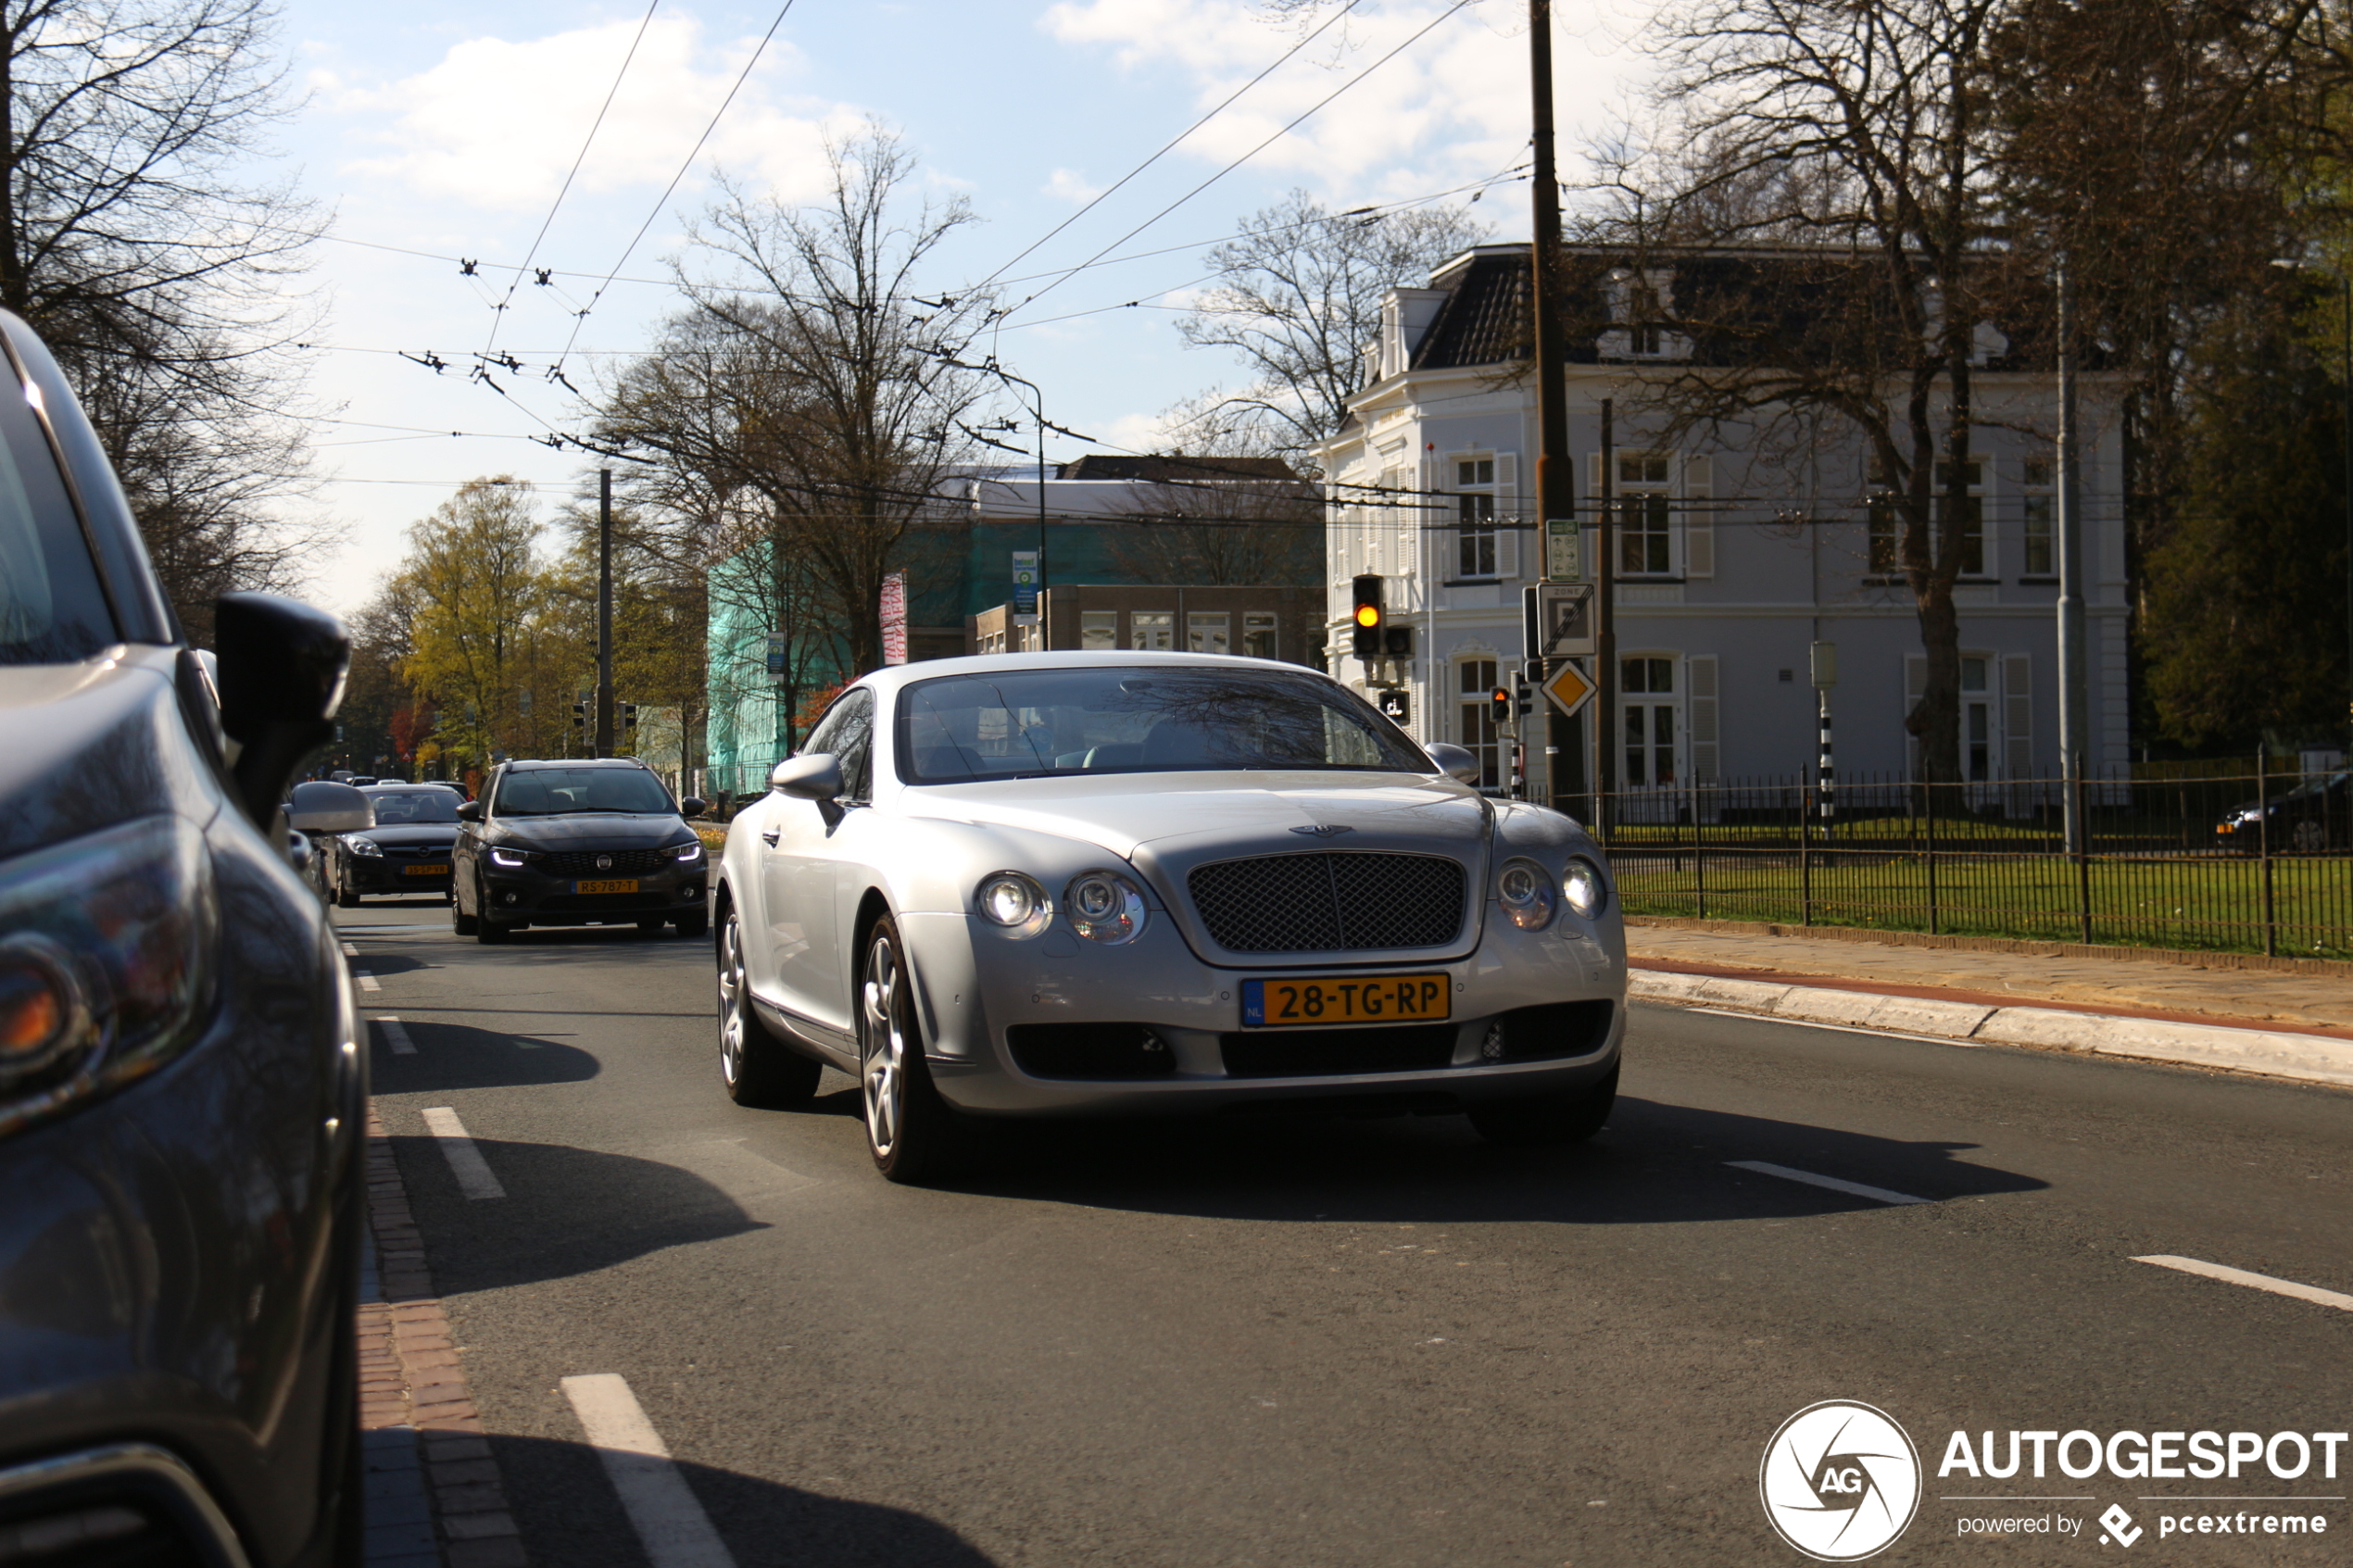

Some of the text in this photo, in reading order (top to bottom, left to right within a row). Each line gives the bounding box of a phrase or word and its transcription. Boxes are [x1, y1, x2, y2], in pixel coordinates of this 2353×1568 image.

[1554, 587, 1579, 596] ZONE
[582, 881, 634, 893] RS-787-T
[1247, 981, 1439, 1019] NL 28-TG-RP
